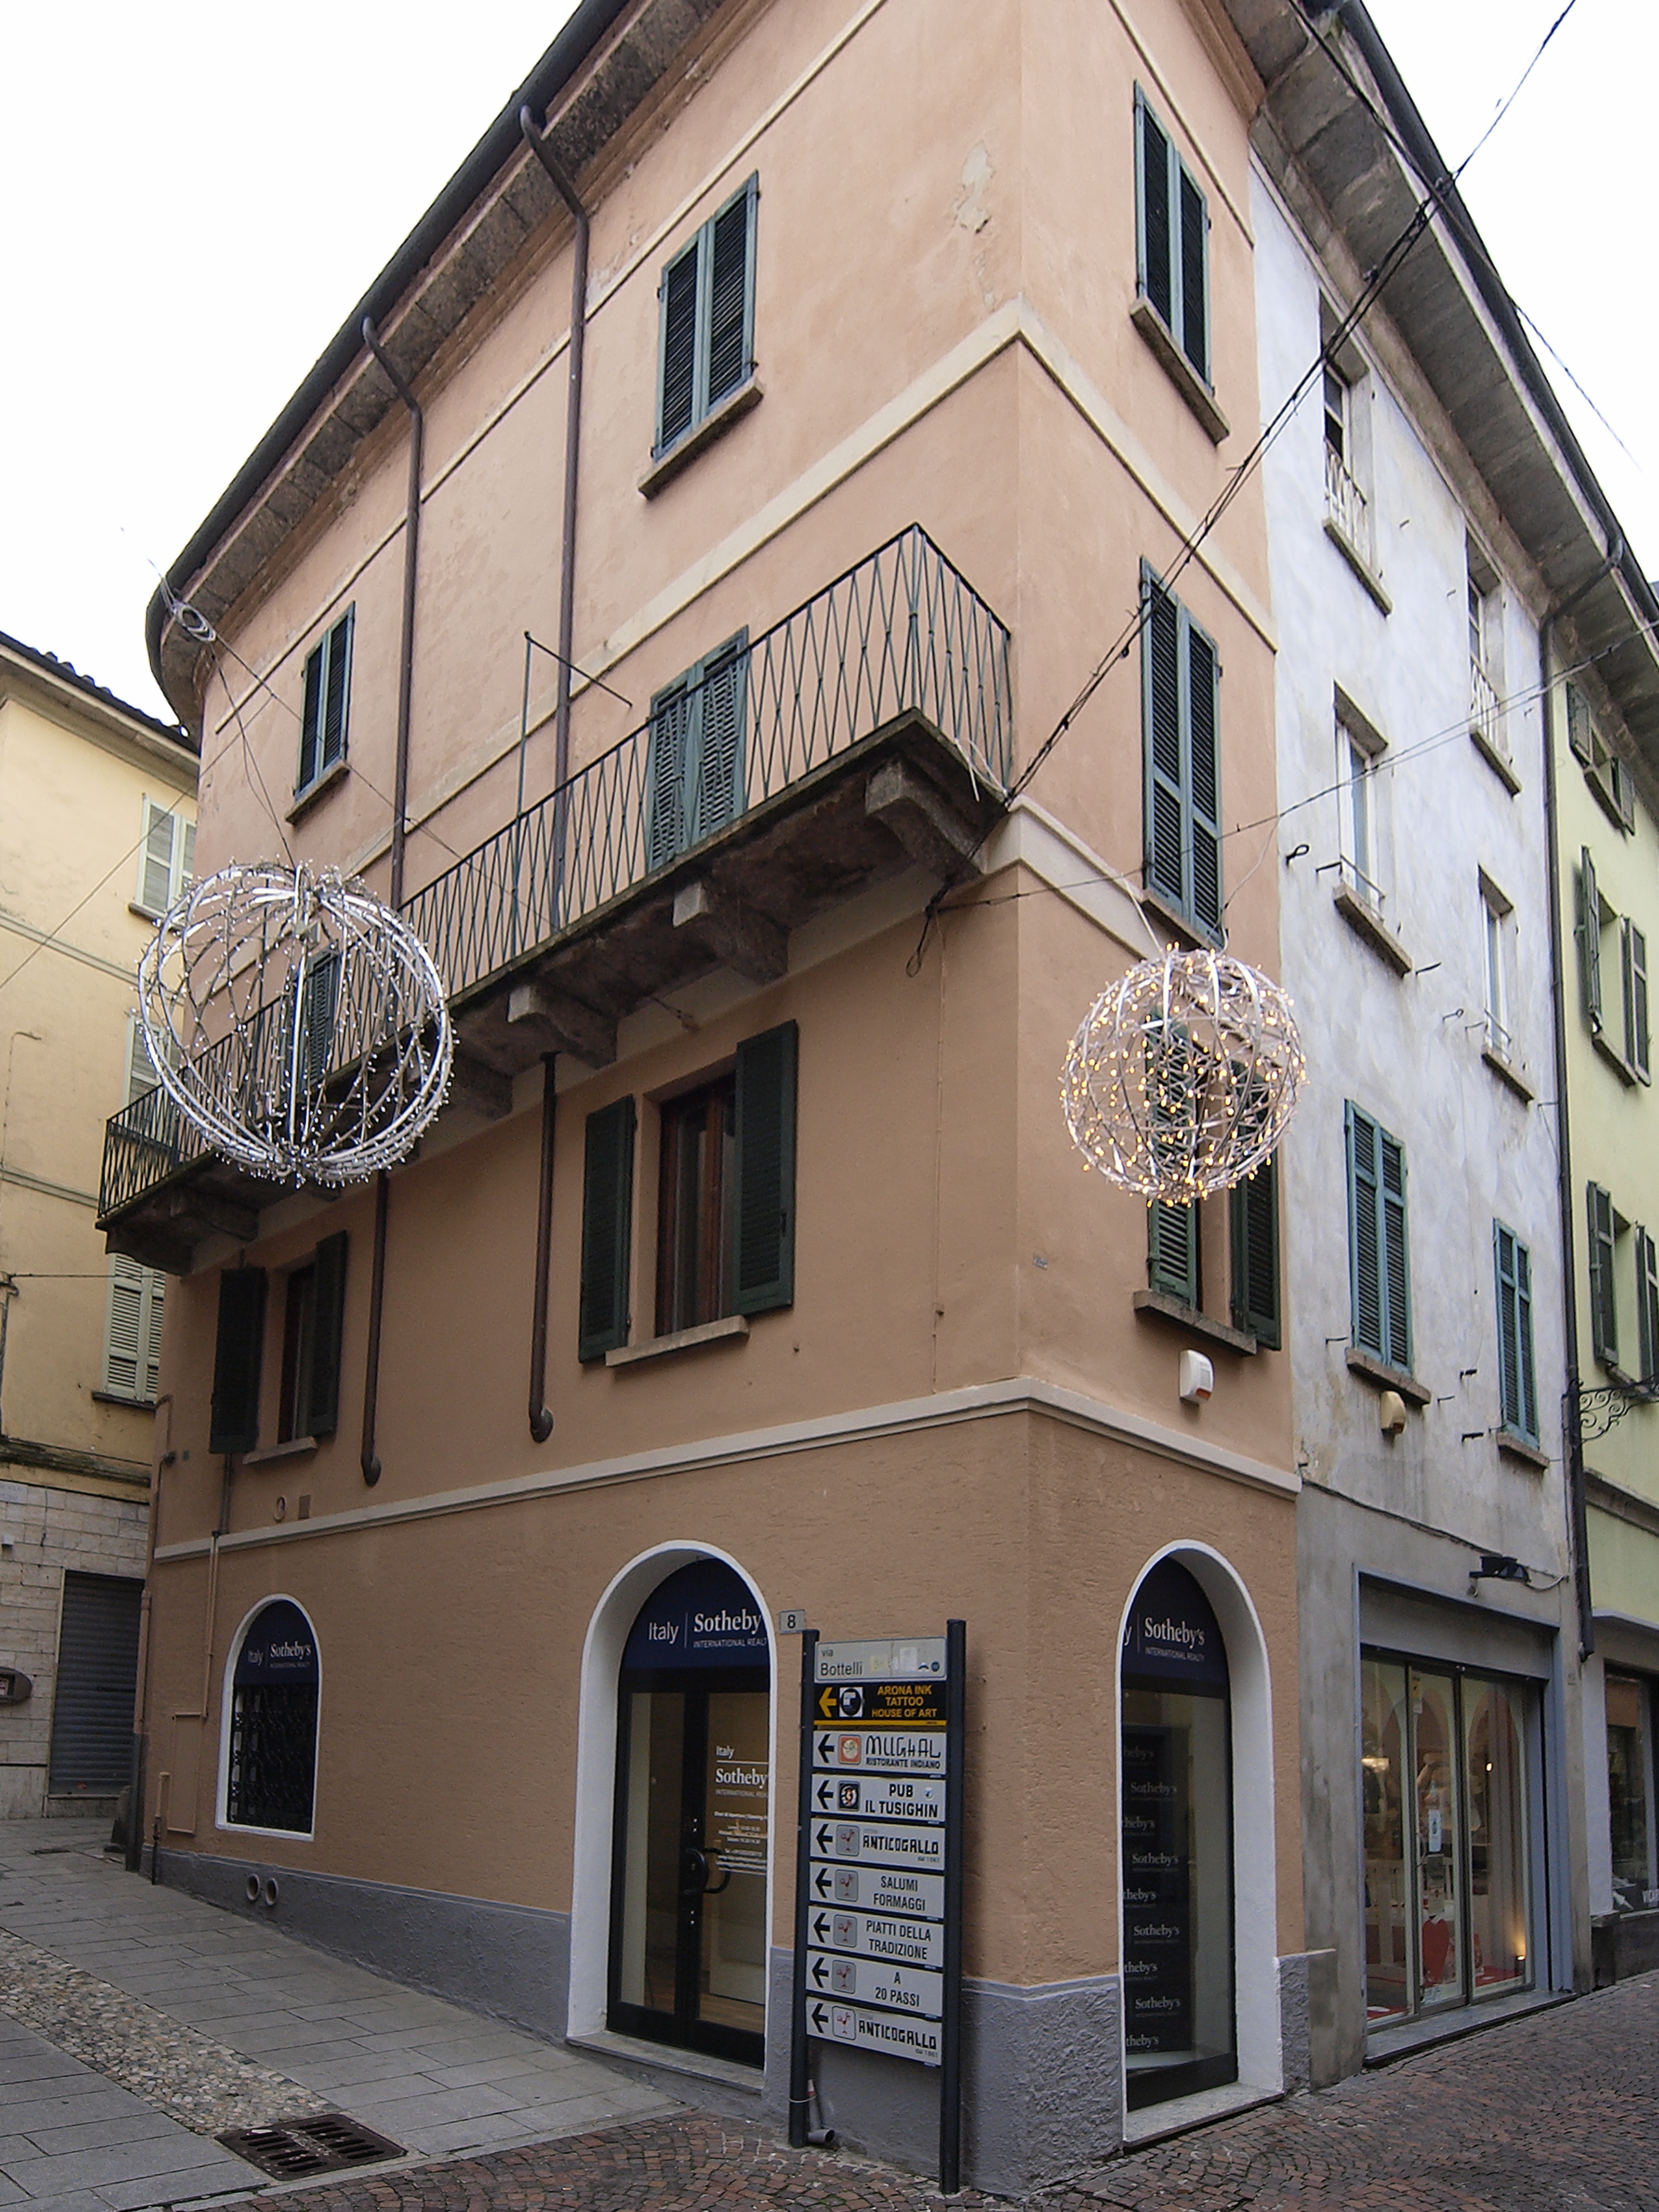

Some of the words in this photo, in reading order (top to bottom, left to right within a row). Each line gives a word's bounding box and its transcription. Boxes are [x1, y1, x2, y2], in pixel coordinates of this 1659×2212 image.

[787, 1614, 796, 1629] 8
[649, 1622, 679, 1644] Italy
[1145, 1616, 1205, 1649] Sotheby's
[269, 1641, 312, 1659] Sotheby's
[821, 1647, 834, 1657] via
[821, 1661, 862, 1676] Bottelli
[877, 1685, 913, 1696] ARONA
[915, 1685, 932, 1695] INK
[885, 1696, 924, 1707] TATTOO
[871, 1709, 903, 1717] HOUSE
[904, 1709, 917, 1717] OF
[918, 1708, 938, 1717] ART
[716, 1746, 734, 1759] Italy
[866, 1758, 908, 1768] RISTORANTE
[910, 1759, 940, 1769] INDIANO
[889, 1783, 914, 1798] PUB
[1130, 1781, 1178, 1796] Sotheby's
[865, 1800, 875, 1813] IL
[879, 1801, 938, 1818] TUSIGHIN
[863, 1834, 939, 1854] ANTICOGALLO
[1132, 1852, 1179, 1866] Sotheby's
[881, 1875, 918, 1892] SALUMI
[873, 1893, 926, 1911] FORMAGGI
[866, 1920, 896, 1936] PIATTI
[900, 1925, 931, 1942] DELLA
[1133, 1923, 1180, 1938] Sotheby's
[868, 1938, 928, 1960] TRADIZIONE
[894, 1972, 901, 1984] A
[875, 1987, 887, 2001] 20
[890, 1990, 920, 2007] PASSI
[1134, 1997, 1181, 2010] Sotheby's
[858, 2020, 937, 2050] ANTICOGALLO
